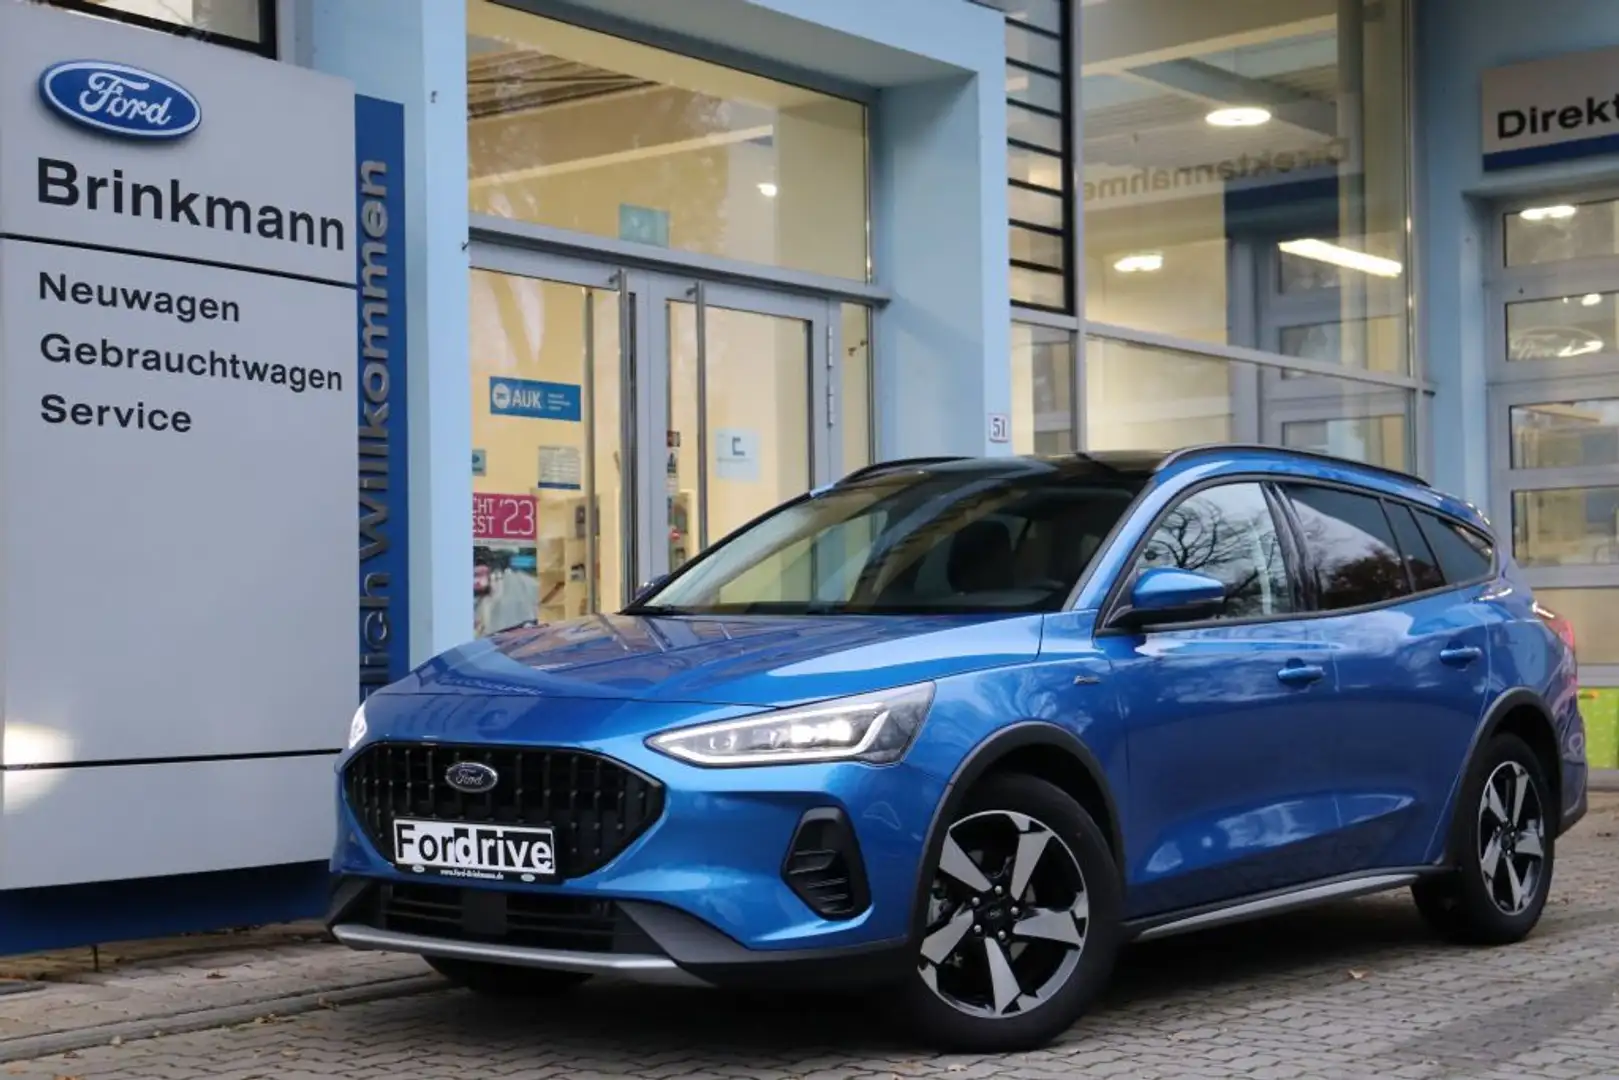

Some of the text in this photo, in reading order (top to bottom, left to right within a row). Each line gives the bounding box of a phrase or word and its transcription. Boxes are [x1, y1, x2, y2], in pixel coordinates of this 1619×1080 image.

[79, 72, 172, 127] Ford
[1497, 93, 1619, 140] Direkt
[37, 157, 345, 251] Brinkmann
[39, 271, 240, 322] Neuwagen
[40, 333, 342, 392] Gebrauchtwagen
[358, 160, 391, 565] Willkommen
[40, 394, 192, 432] Service
[993, 417, 1006, 438] 51
[456, 768, 484, 785] Ford
[396, 824, 553, 871] Fordrive
